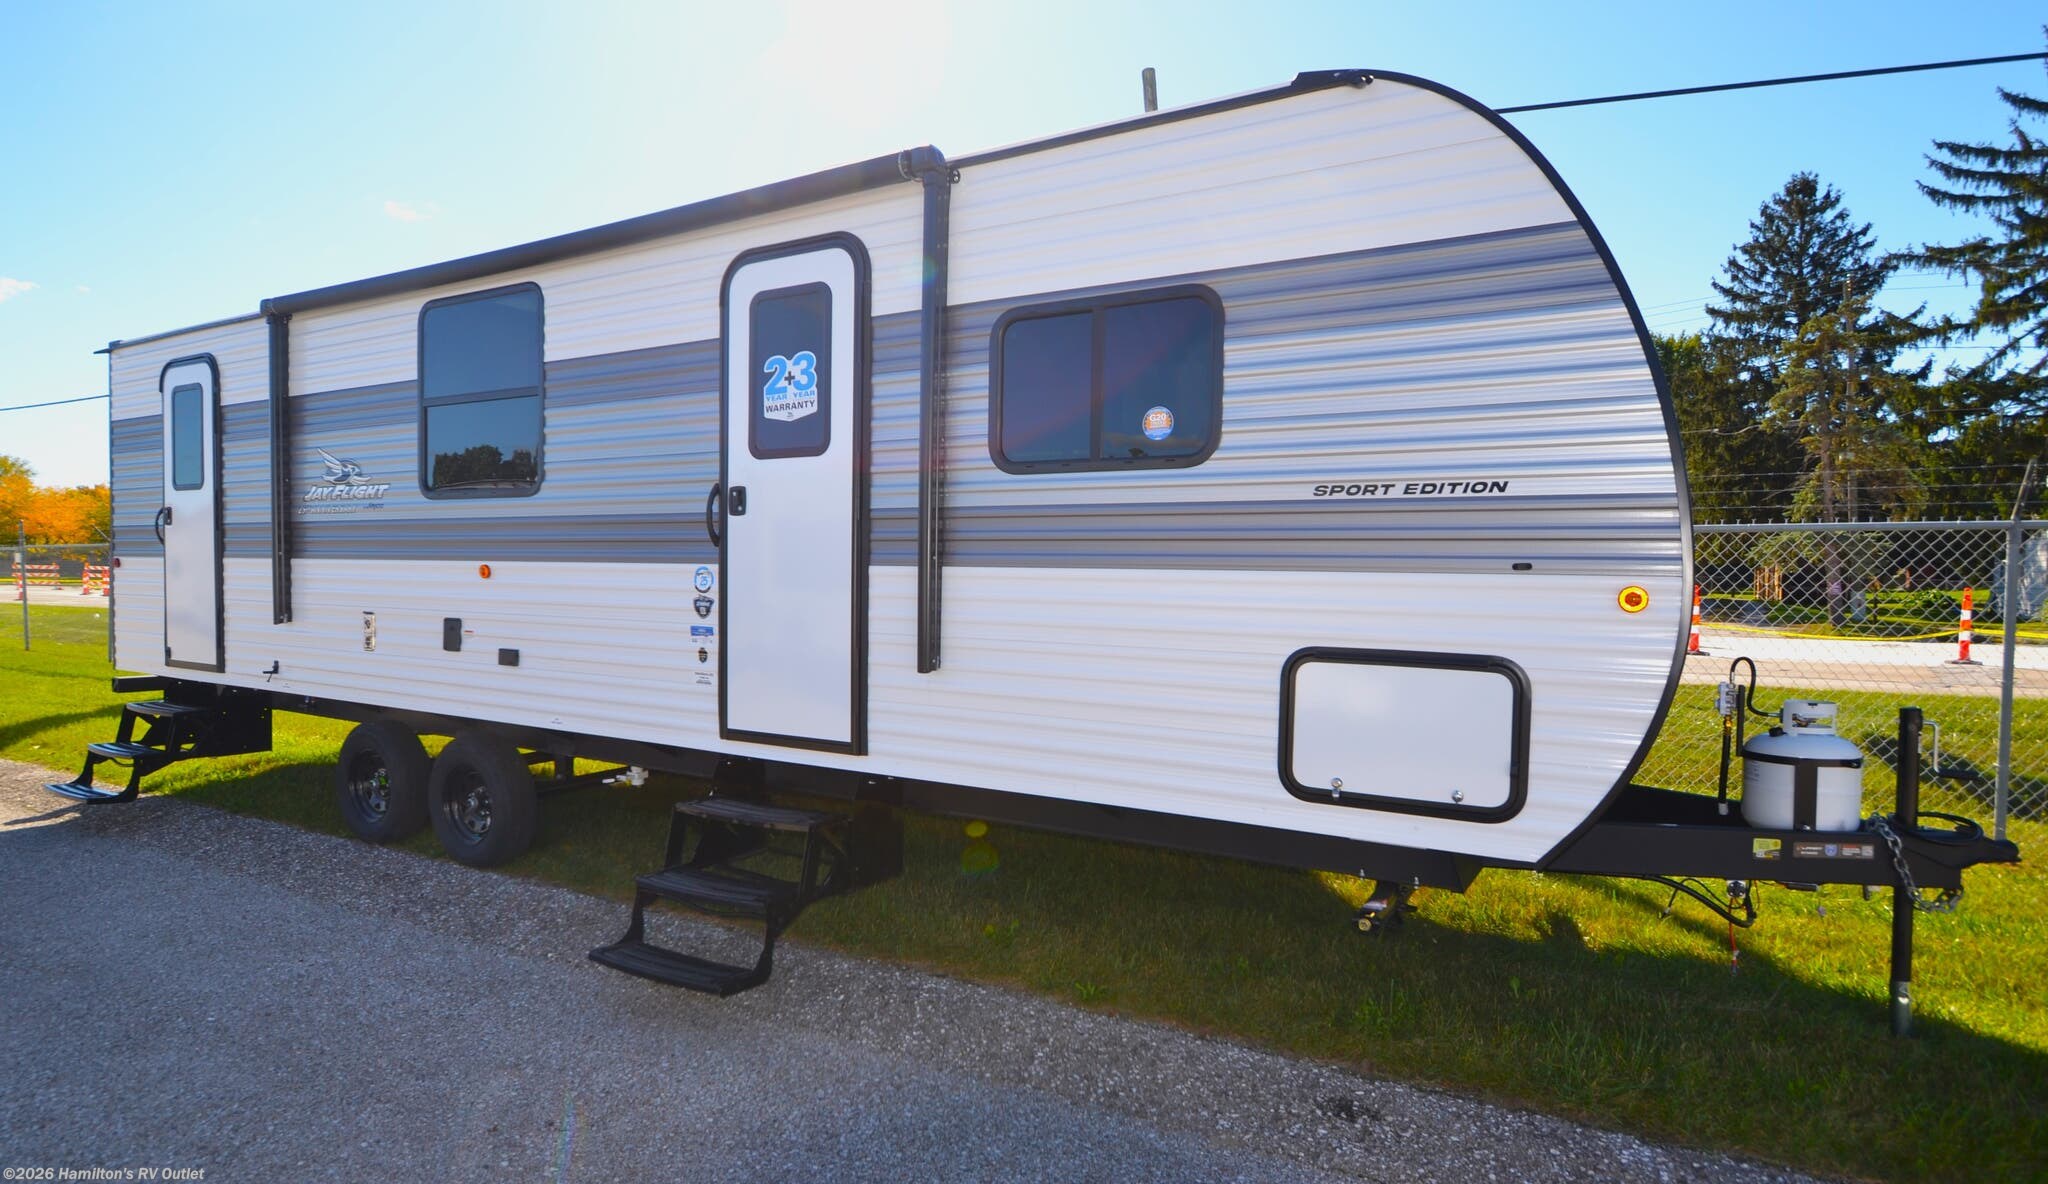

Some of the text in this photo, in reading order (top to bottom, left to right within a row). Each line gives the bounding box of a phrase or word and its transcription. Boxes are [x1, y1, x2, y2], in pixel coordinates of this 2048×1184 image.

[766, 390, 815, 402] YEAR YEAR
[765, 400, 815, 413] WARRANTY
[1313, 481, 1509, 497] SPORT EDITION
